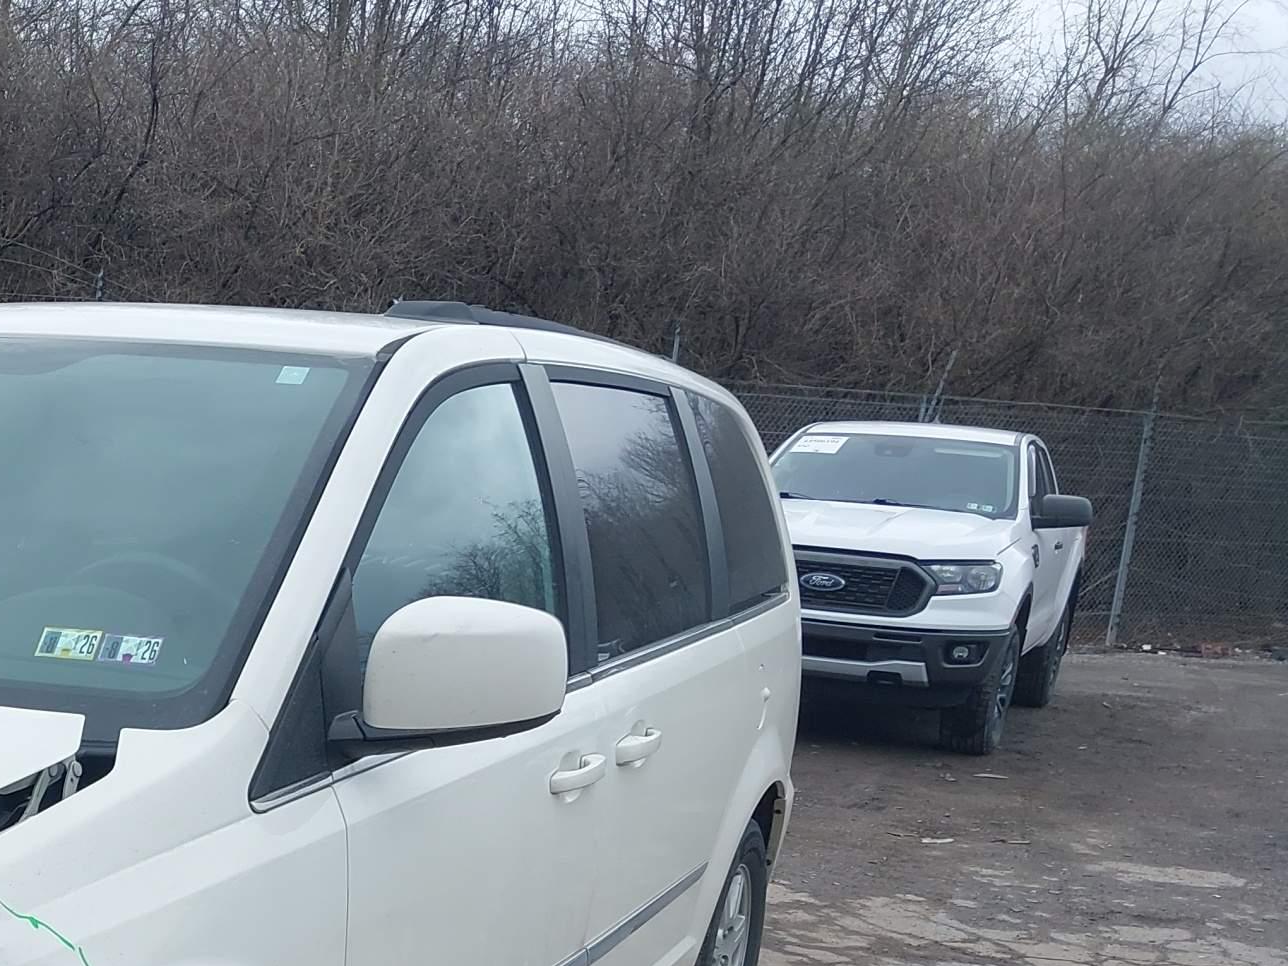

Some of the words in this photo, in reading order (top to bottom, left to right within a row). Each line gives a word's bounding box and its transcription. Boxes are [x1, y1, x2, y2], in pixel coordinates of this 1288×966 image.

[809, 575, 835, 587] Ford
[78, 634, 98, 655] 26
[140, 640, 160, 661] 26
